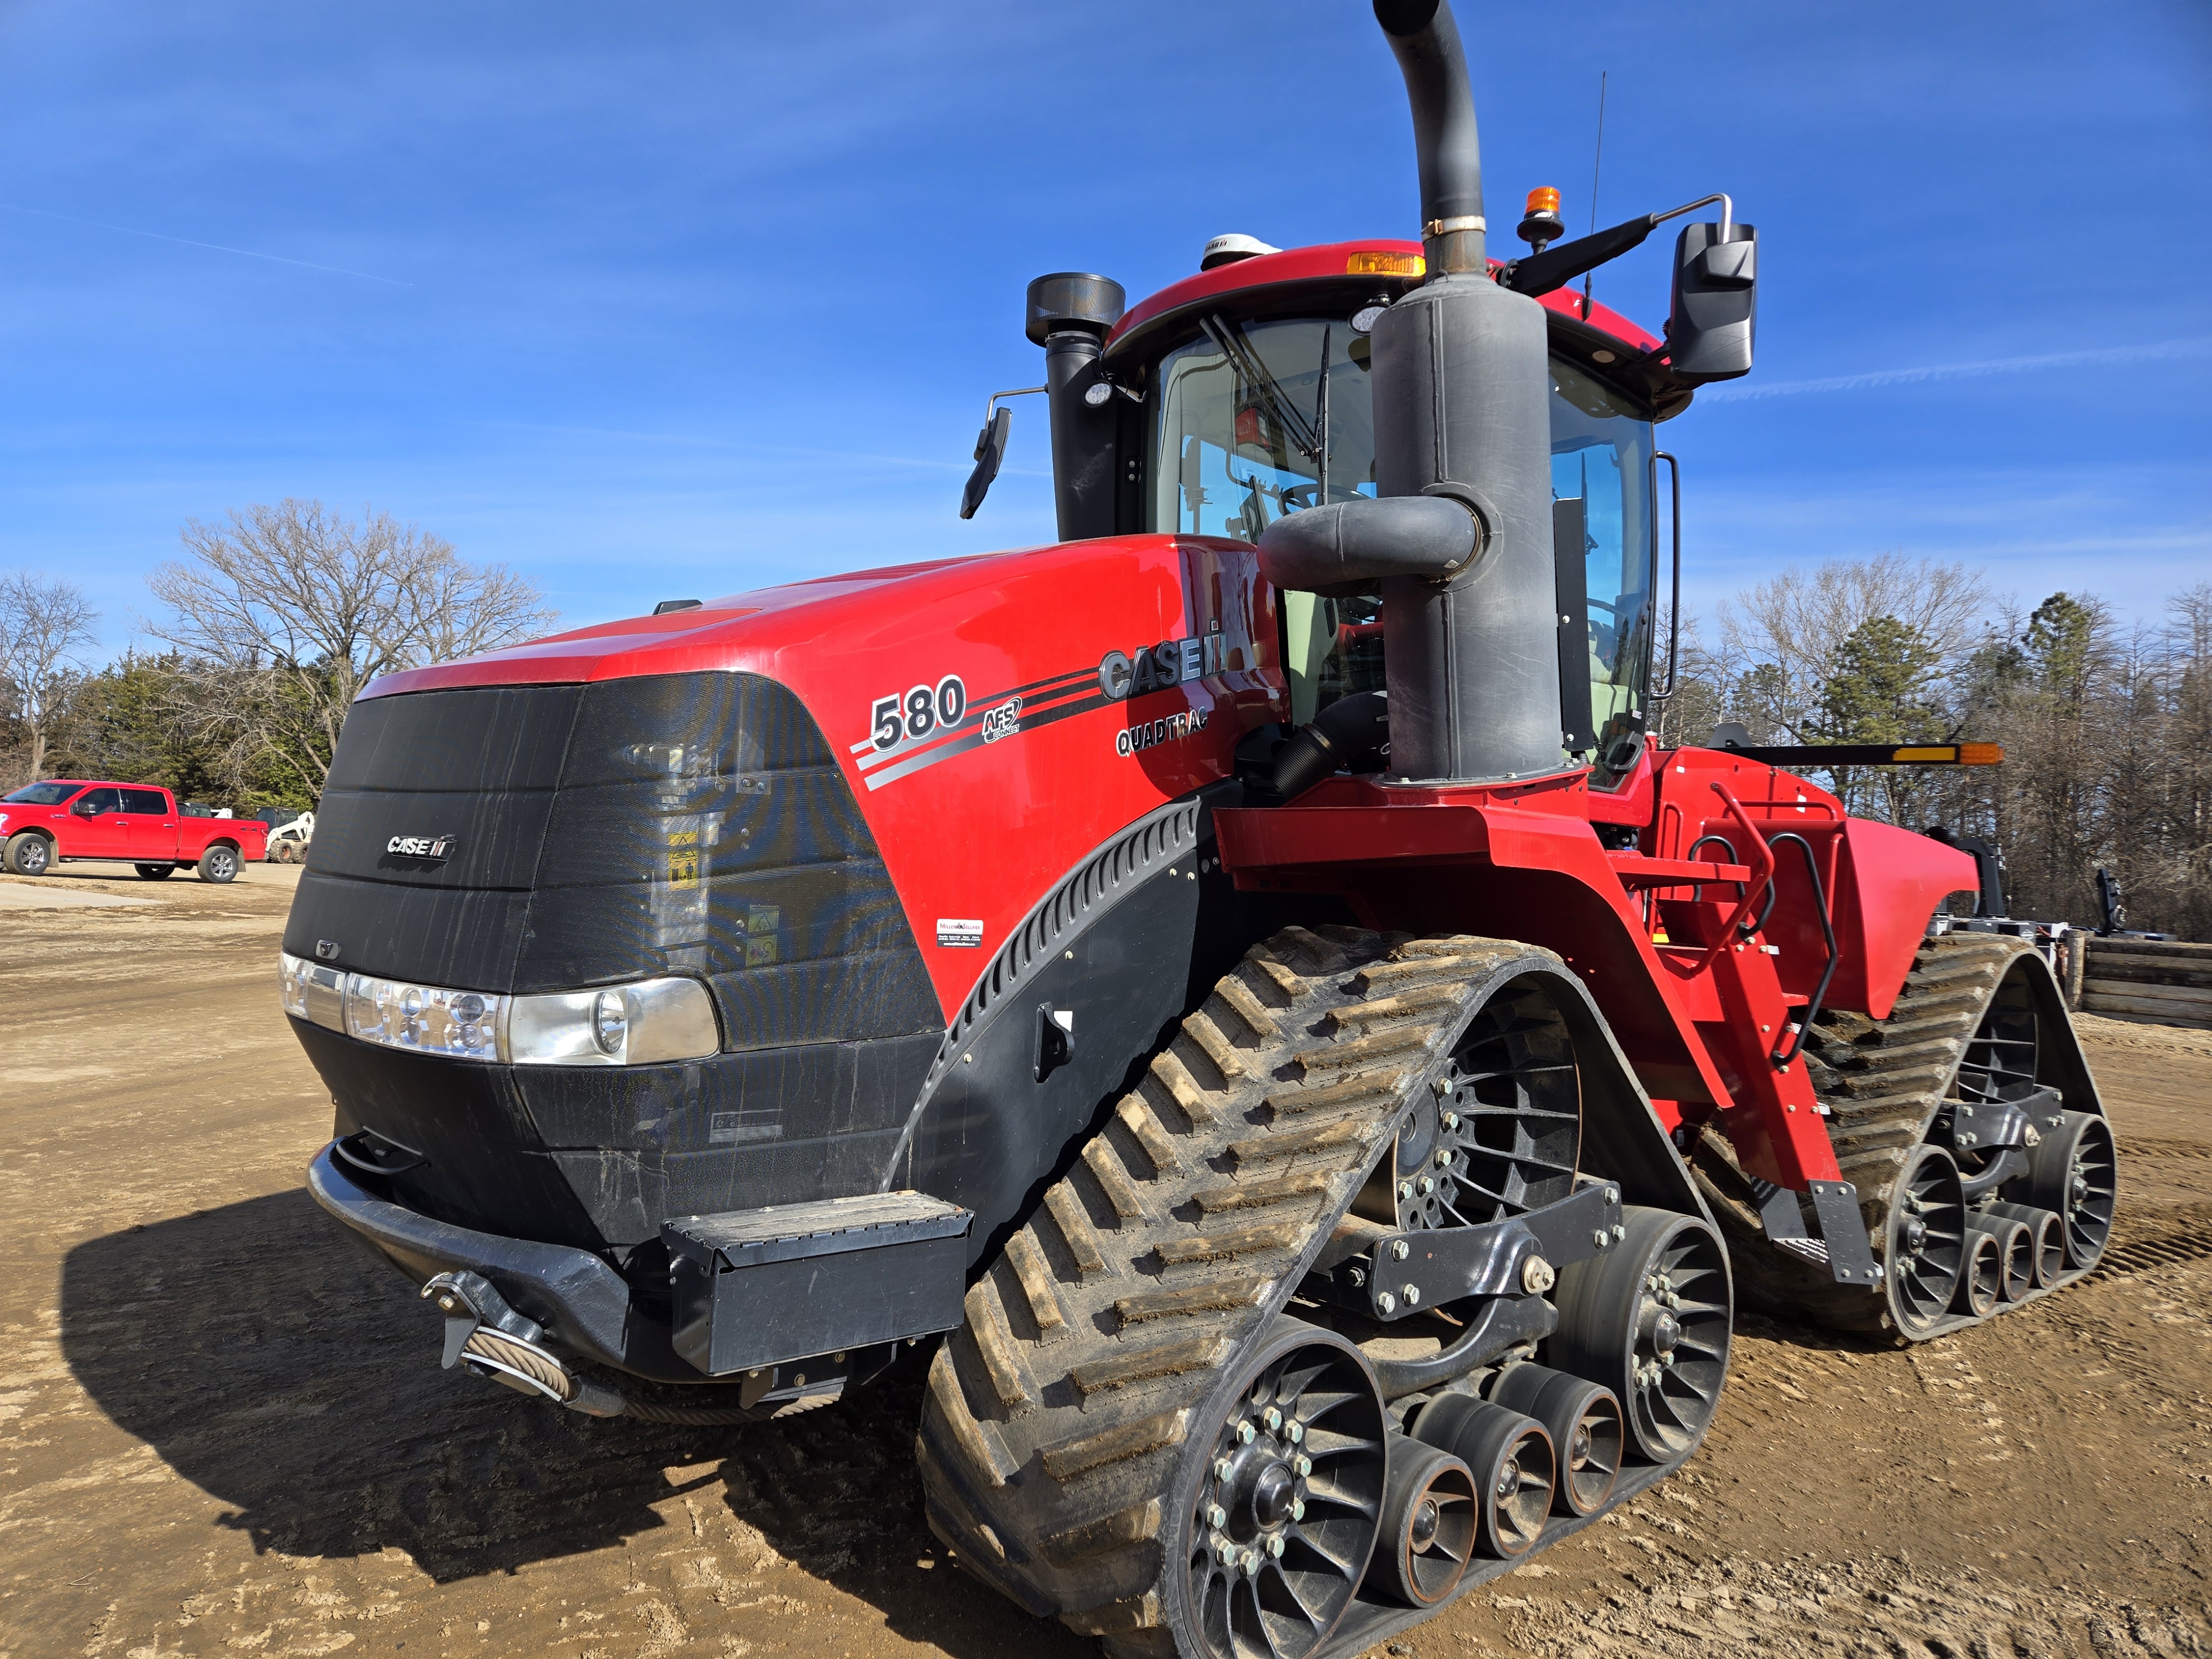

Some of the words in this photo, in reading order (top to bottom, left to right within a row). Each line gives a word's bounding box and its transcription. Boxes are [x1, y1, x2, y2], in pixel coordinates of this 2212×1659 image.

[1099, 639, 1201, 701] CASE
[869, 674, 966, 753] 580
[982, 702, 1014, 735] AFS
[993, 724, 1019, 739] CONNECT
[1116, 706, 1208, 758] QUADTRAC
[387, 836, 430, 854] CASE
